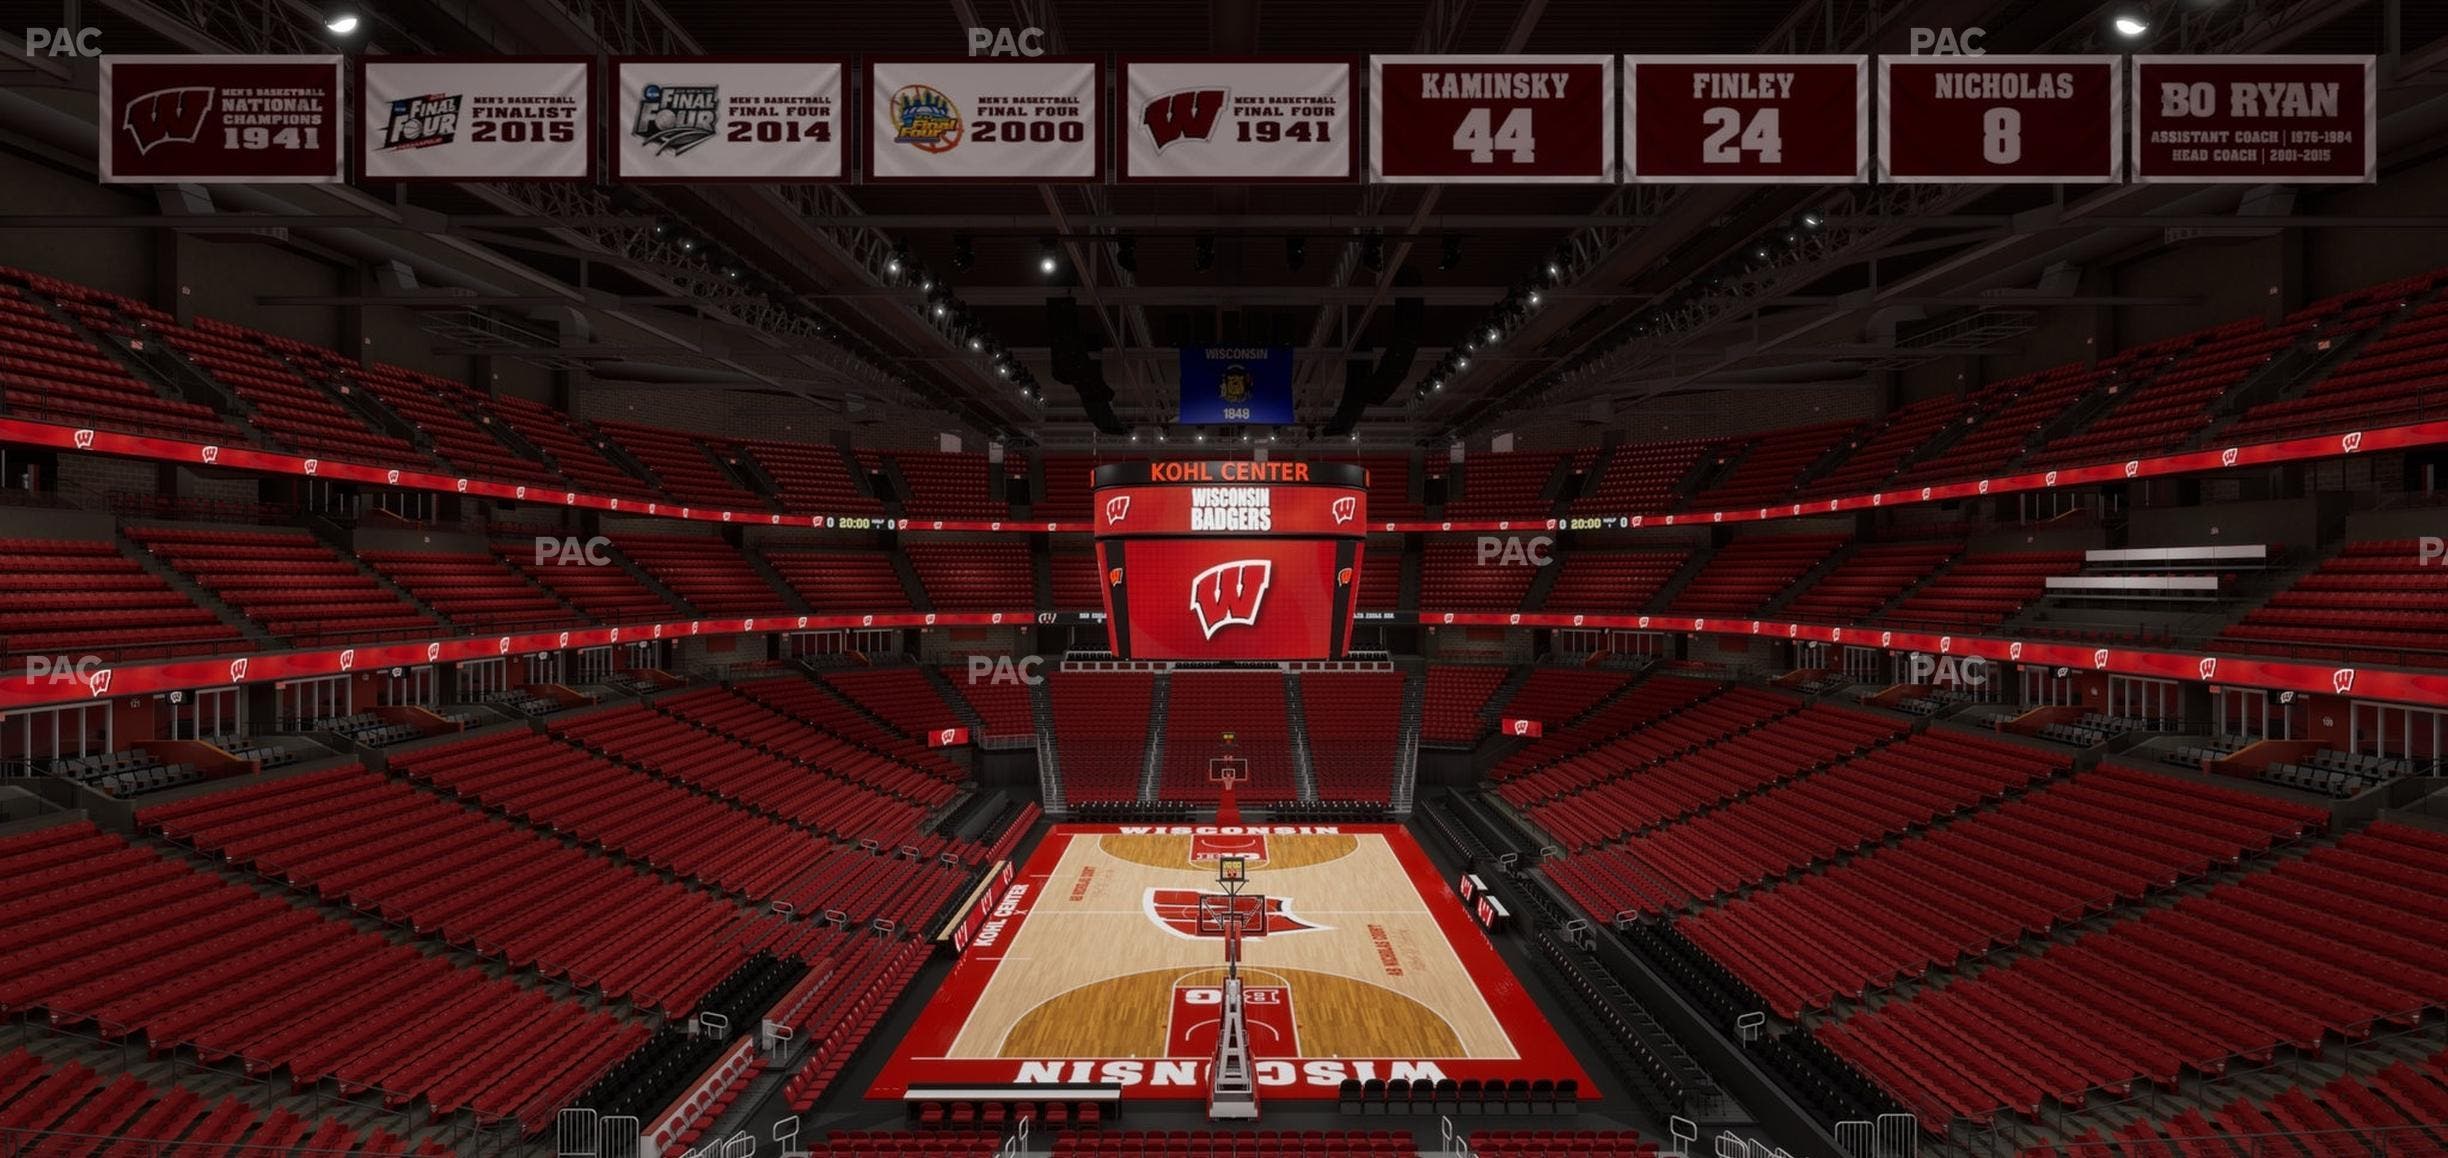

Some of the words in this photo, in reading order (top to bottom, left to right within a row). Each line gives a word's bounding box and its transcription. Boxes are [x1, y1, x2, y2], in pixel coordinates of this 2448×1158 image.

[256, 88, 325, 97] BASKETBALL
[1421, 73, 1570, 99] KAMINSKY
[1692, 72, 1795, 100] FINLEY
[1935, 72, 2074, 99] NICHOLAS
[222, 98, 323, 112] NATIONAL
[661, 87, 718, 109] FINAL
[2160, 81, 2217, 117] BO
[2230, 81, 2340, 118] RYAN
[223, 113, 322, 125] CHAMPIONS
[472, 107, 576, 118] FINALIST
[729, 106, 778, 117] FINAL
[786, 106, 831, 117] FOUR
[978, 106, 1027, 117] FINAL
[1035, 106, 1079, 117] FOUR
[1234, 106, 1283, 117] FINAL
[1291, 106, 1335, 117] FOUR
[224, 127, 320, 149] 1941
[472, 121, 575, 142] 2015
[728, 121, 831, 142] 2014
[971, 121, 1084, 142] 2000
[1237, 121, 1331, 142] 1941
[1452, 108, 1536, 163] 44
[1702, 106, 1782, 164] 24
[1983, 106, 2022, 164] 8
[2151, 130, 2230, 144] ASSISTANT
[2234, 130, 2279, 144] COACH
[2291, 130, 2353, 144] 1976-1984
[2172, 148, 2209, 162] HEAD
[2213, 148, 2258, 162] COACH
[2269, 148, 2332, 162] 2001-2015
[1204, 347, 1269, 360] WISCONSIN
[1223, 407, 1250, 420] 1848
[1151, 461, 1213, 482] KOHL
[1221, 461, 1310, 482] CENTER
[1191, 487, 1271, 508] WISCONSIN
[839, 516, 870, 529] 20:00
[1190, 507, 1271, 532] BADGERS
[1570, 517, 1602, 530] 20:00
[1119, 826, 1339, 836] WISCONSIN
[973, 918, 1008, 947] KOHL
[993, 883, 1030, 917] CENTER
[1012, 1060, 1450, 1086] WISCNSIN
